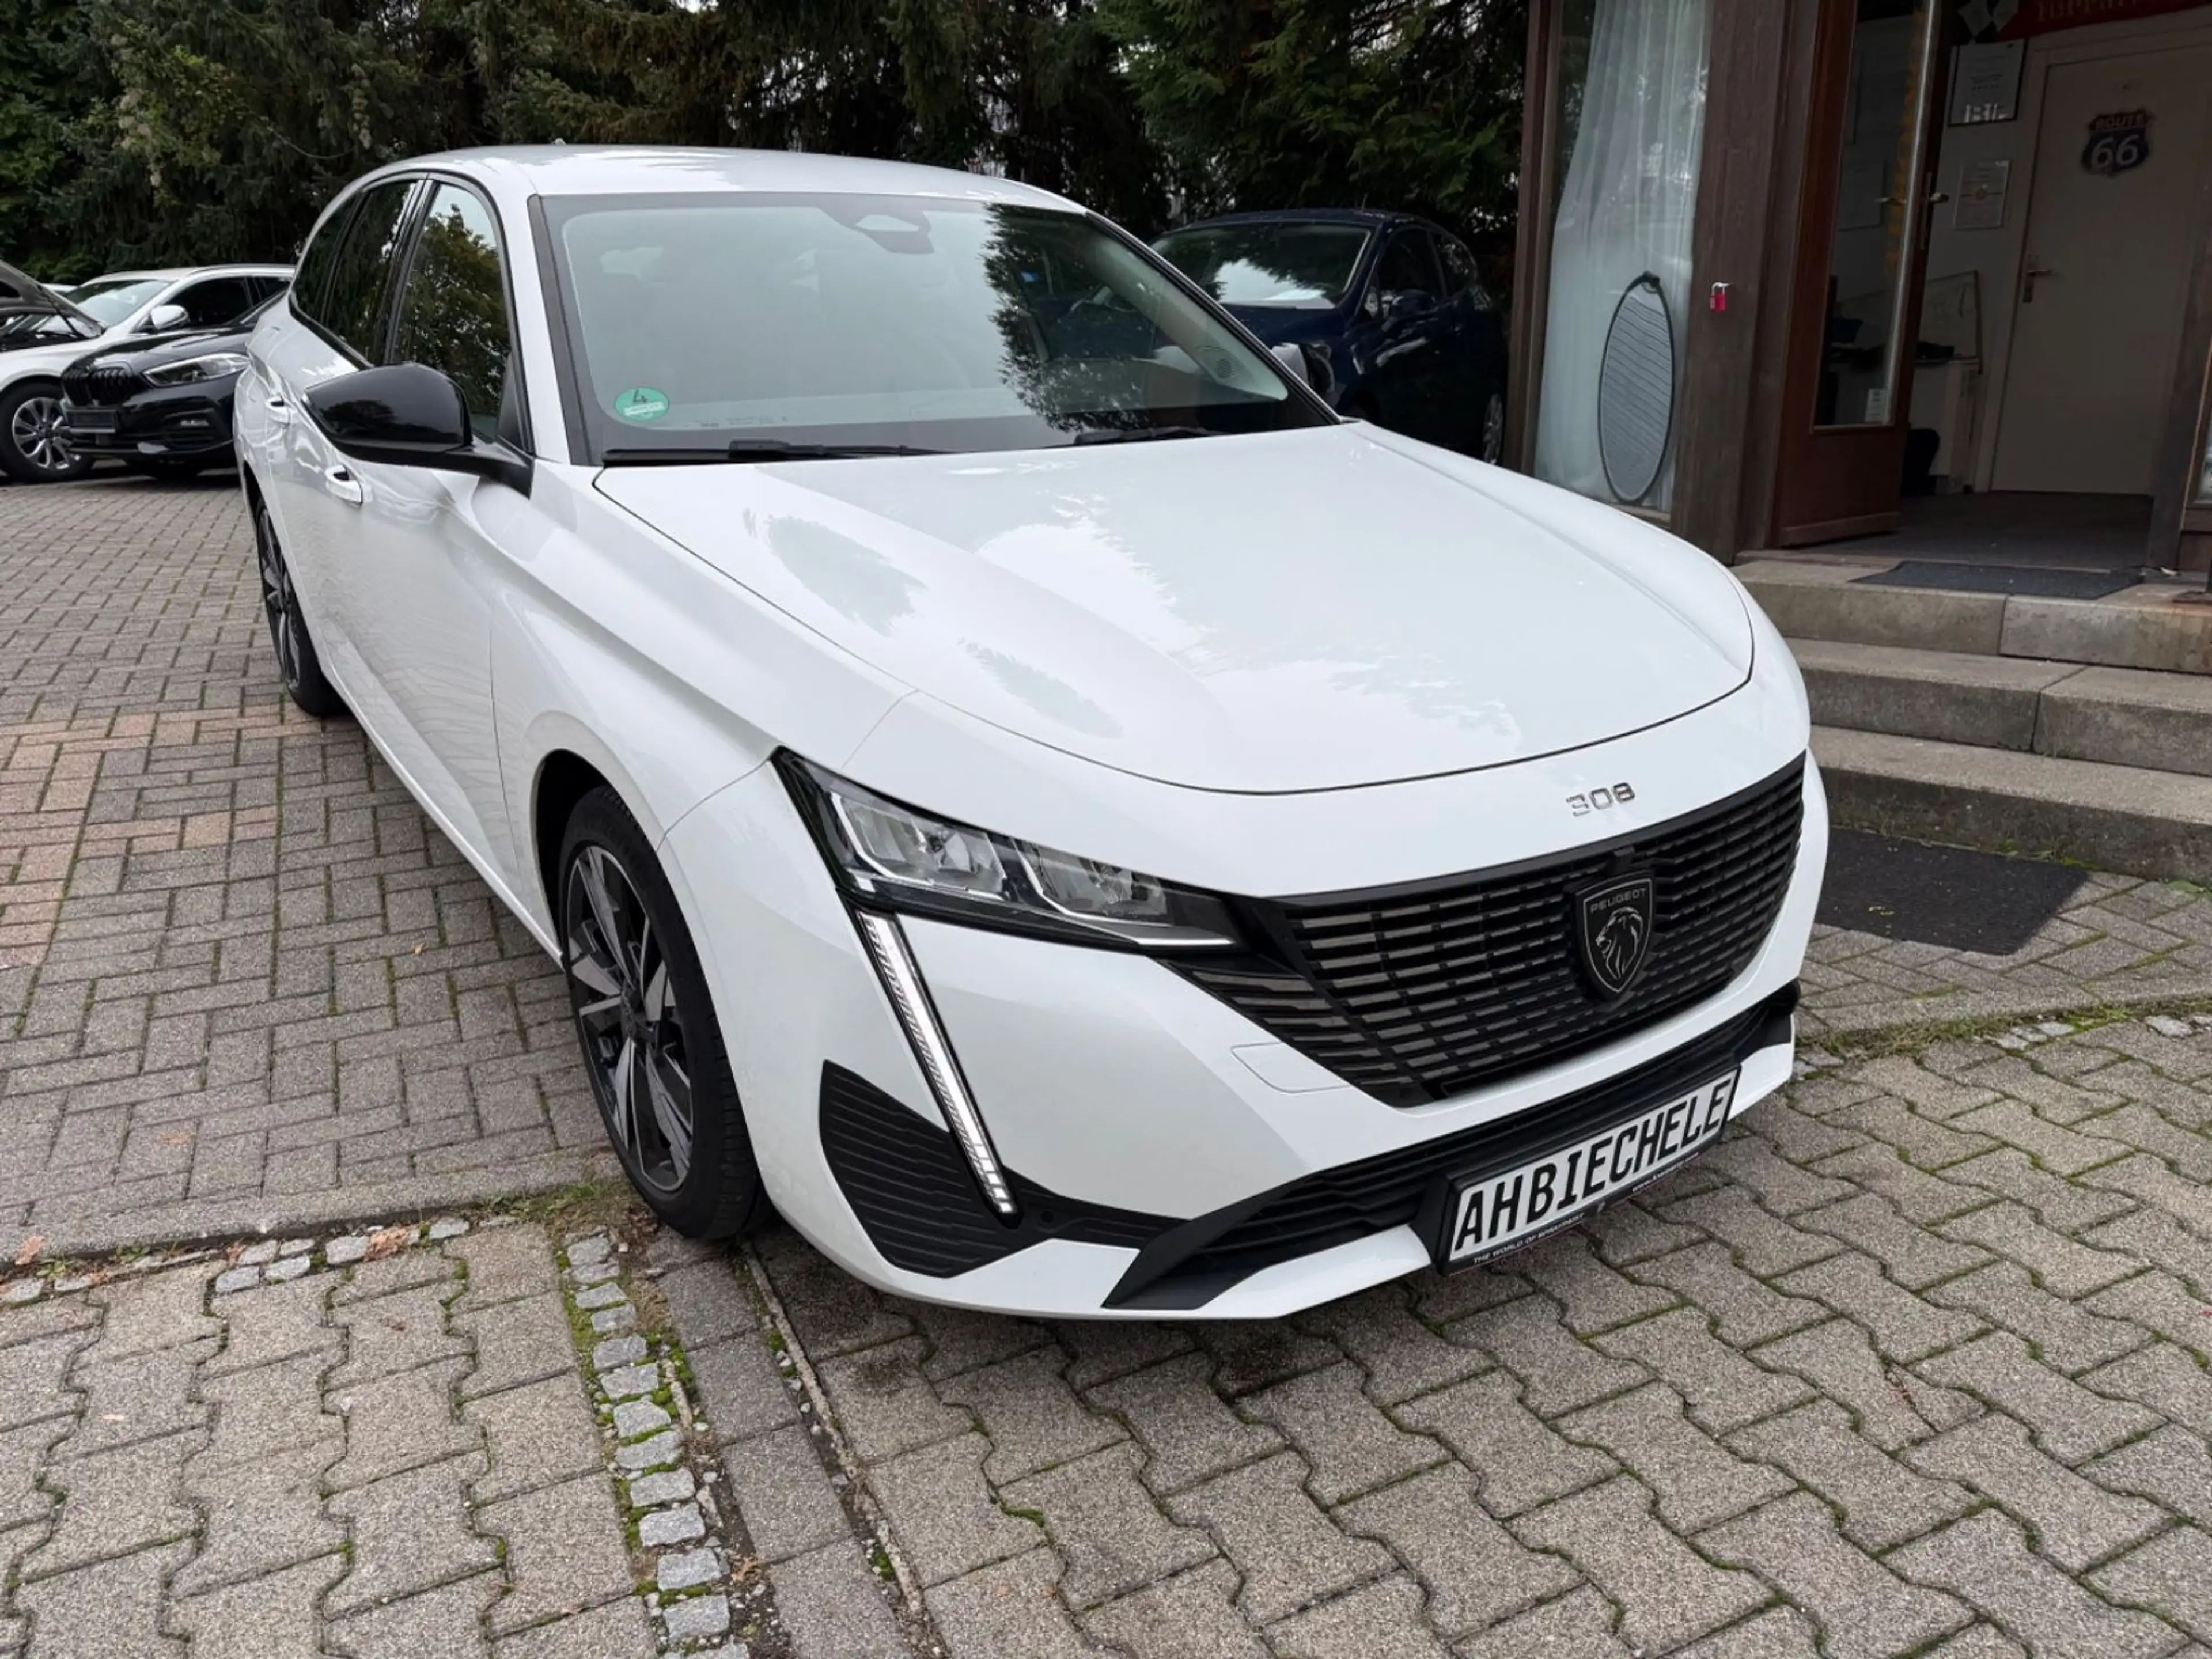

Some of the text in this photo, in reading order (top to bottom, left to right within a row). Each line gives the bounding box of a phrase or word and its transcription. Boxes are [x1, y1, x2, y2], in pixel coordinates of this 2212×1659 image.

[2090, 134, 2140, 169] 66
[633, 389, 648, 403] 4
[1566, 782, 1635, 817] 308
[1590, 887, 1647, 914] PEUGEOT
[1454, 1079, 1732, 1251] AHBIECHELE
